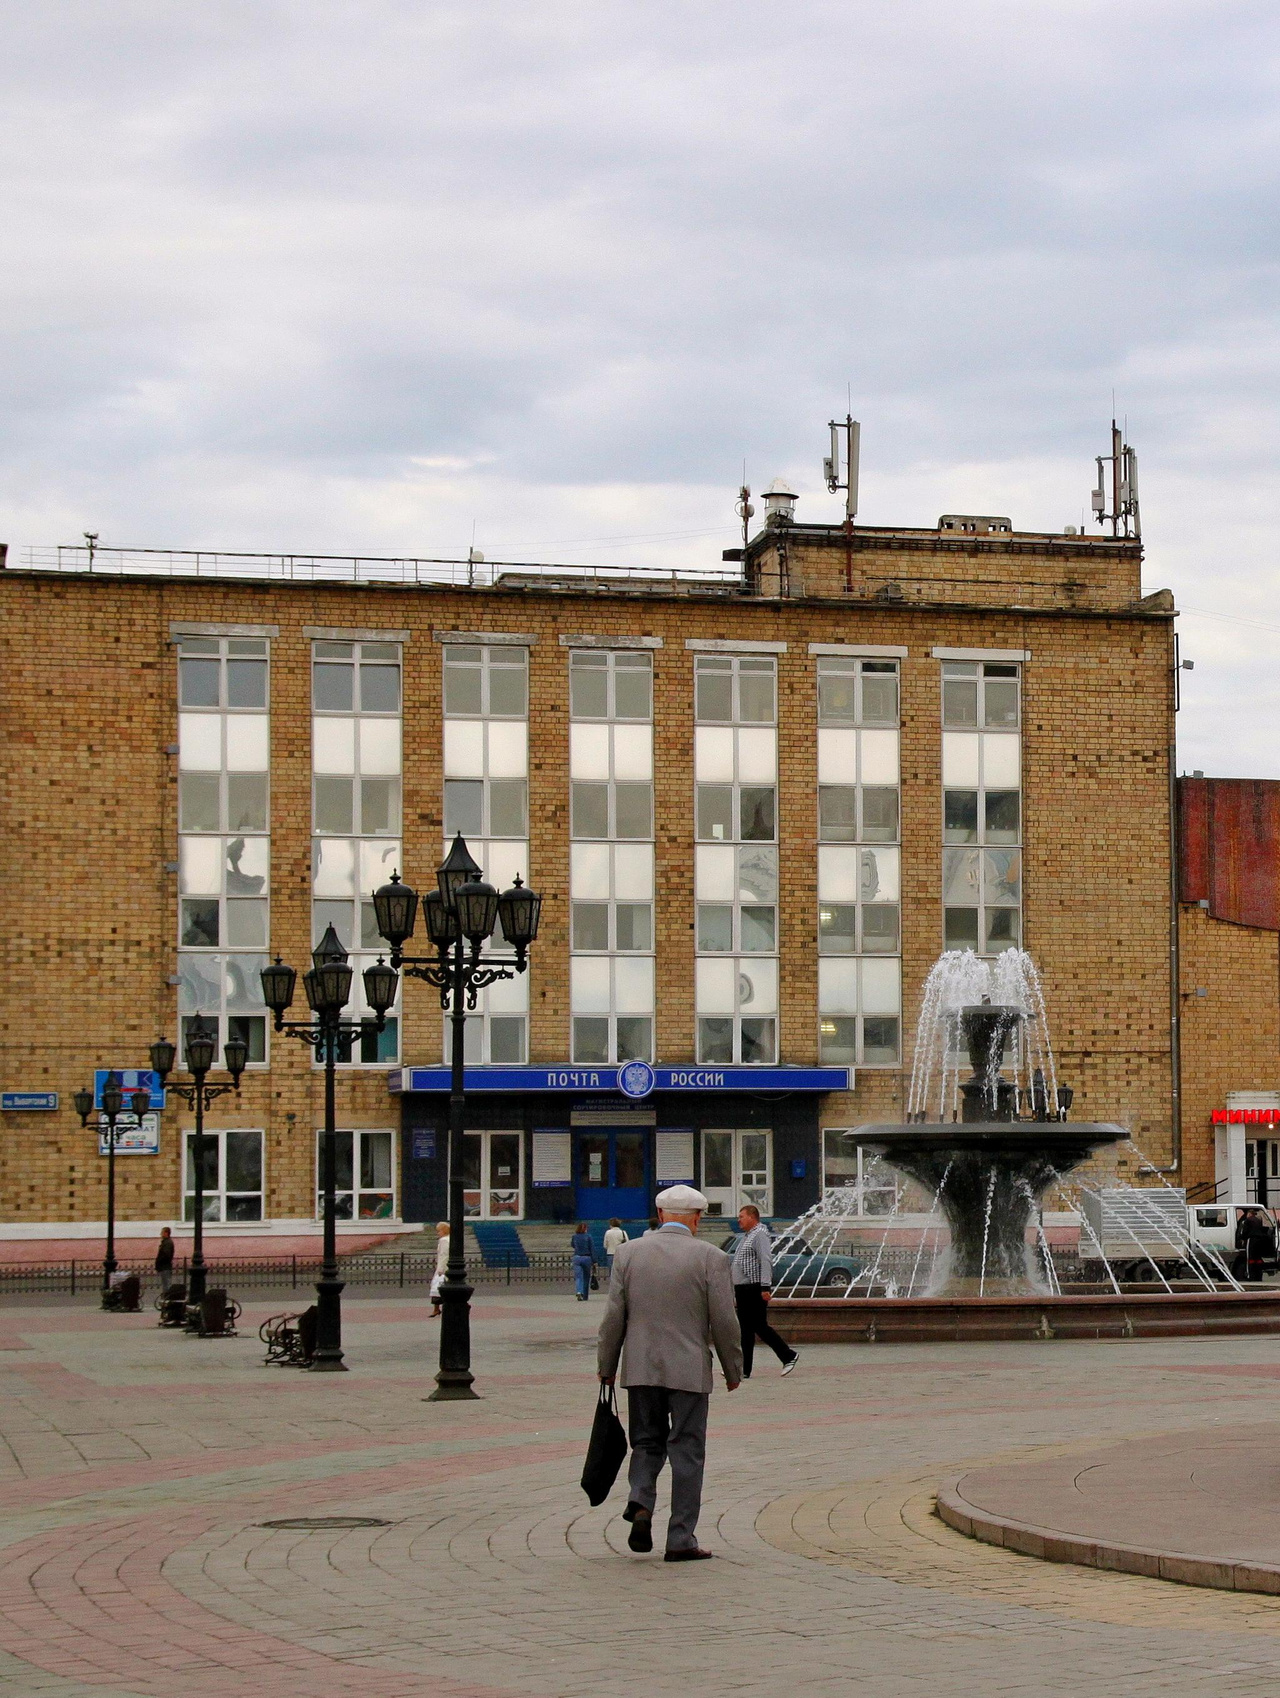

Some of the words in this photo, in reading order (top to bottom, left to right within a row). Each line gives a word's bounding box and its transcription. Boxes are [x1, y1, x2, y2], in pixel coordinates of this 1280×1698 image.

[547, 1072, 600, 1087] ПОЧТА
[670, 1072, 724, 1087] РОССИИ
[48, 1094, 56, 1107] 9
